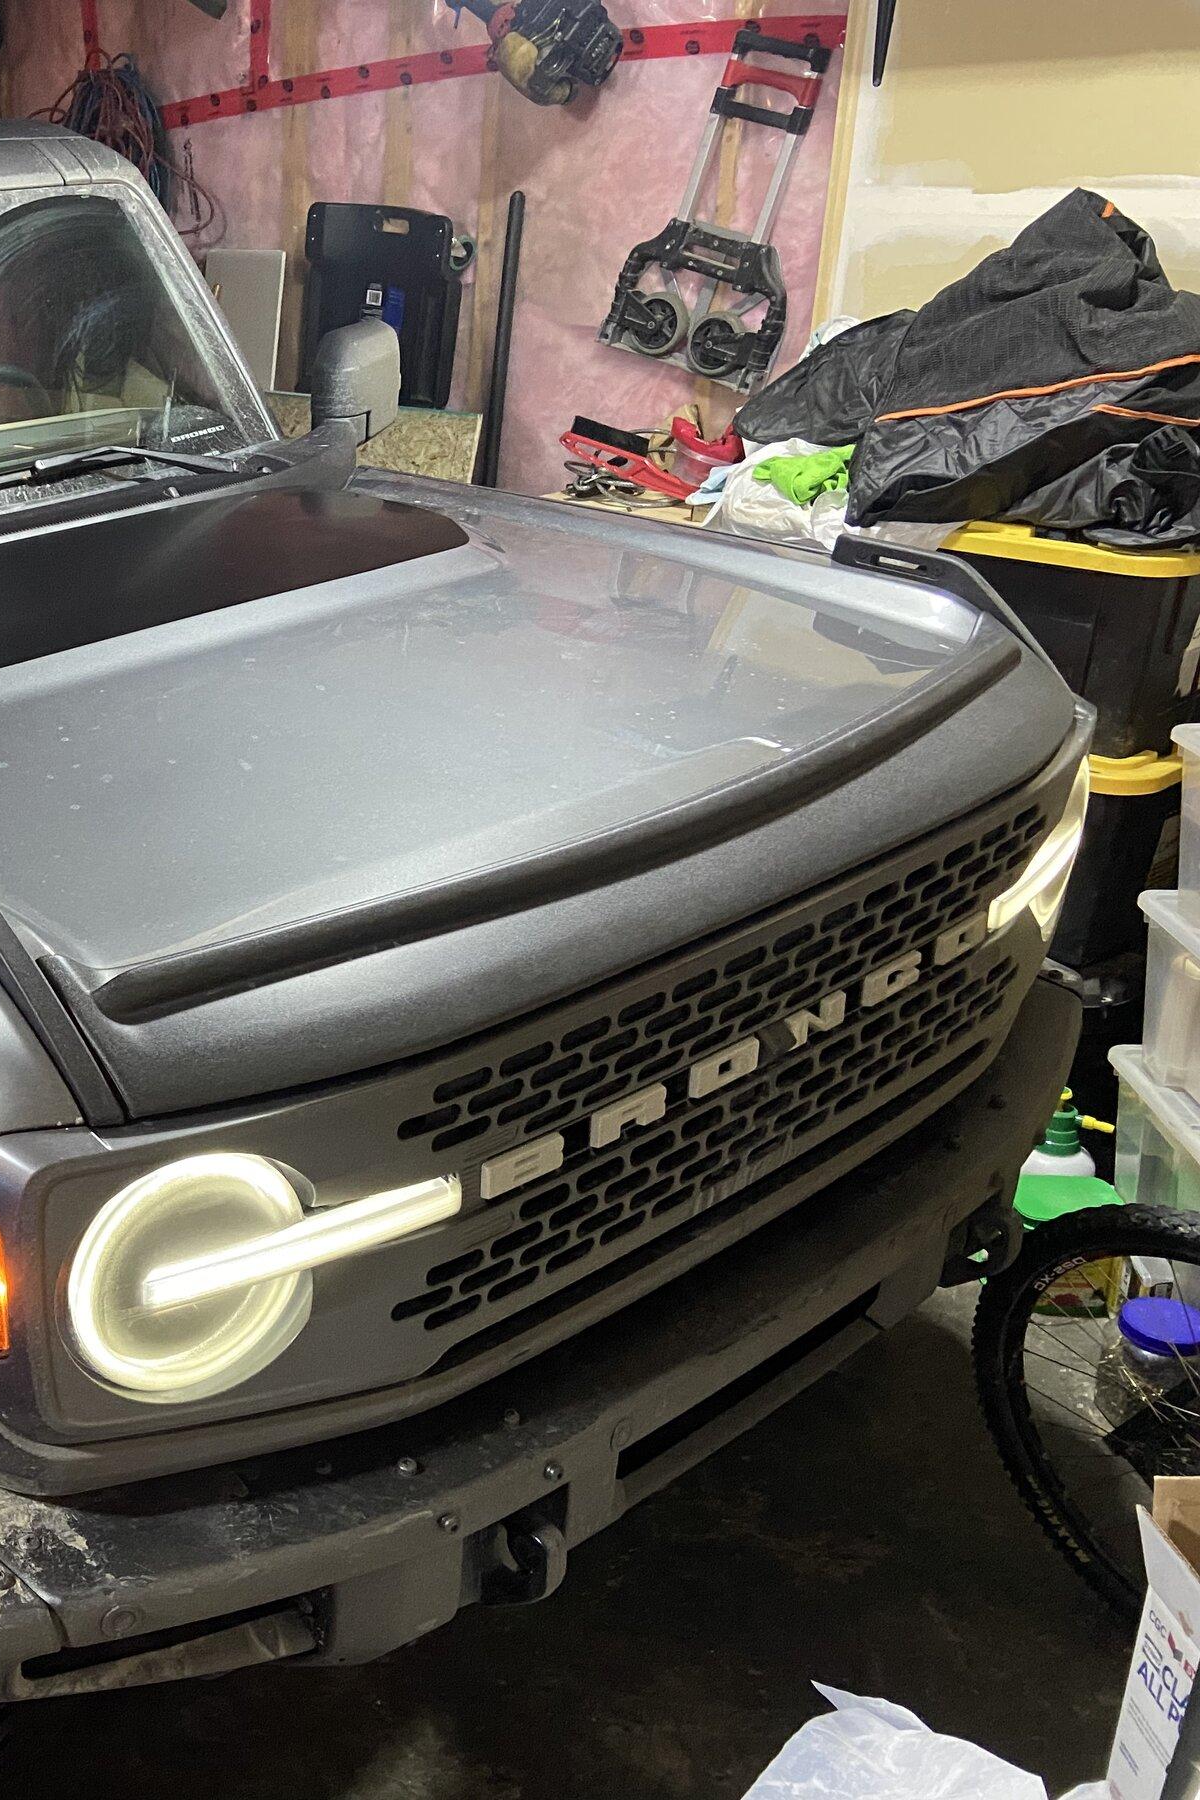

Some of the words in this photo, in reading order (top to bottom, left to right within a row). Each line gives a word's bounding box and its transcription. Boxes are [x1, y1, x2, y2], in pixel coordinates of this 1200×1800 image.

[171, 424, 225, 443] BRONCO
[481, 910, 987, 1200] BRONCO
[1149, 1609, 1167, 1639] CGC
[1136, 1660, 1165, 1712] ALL
